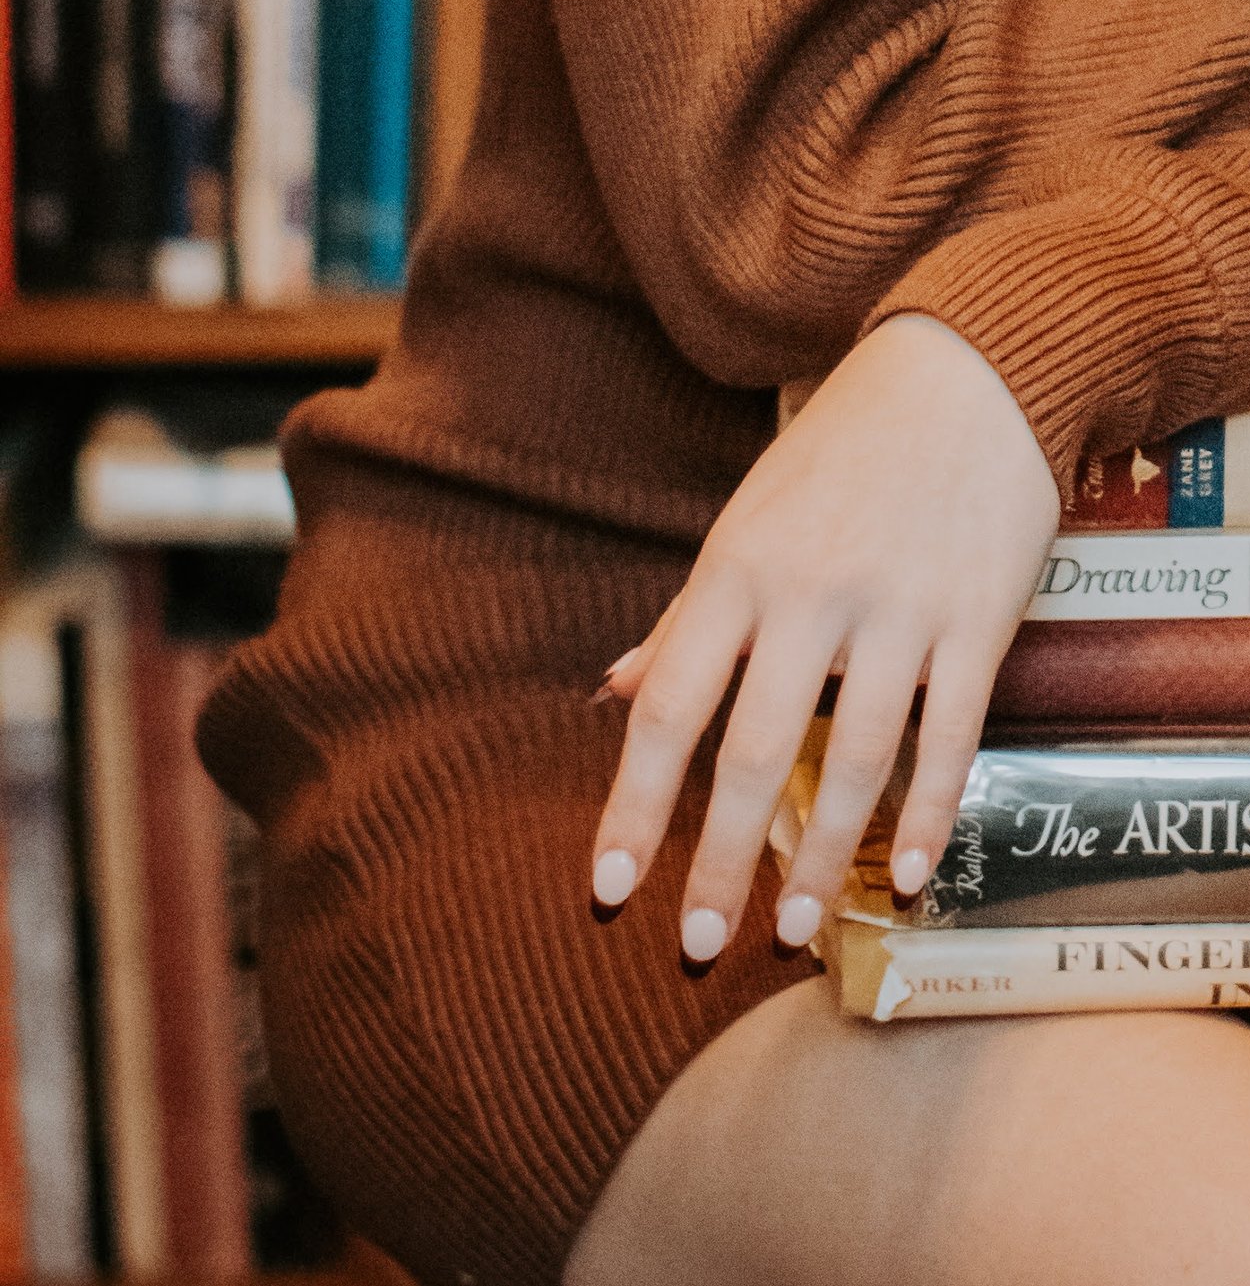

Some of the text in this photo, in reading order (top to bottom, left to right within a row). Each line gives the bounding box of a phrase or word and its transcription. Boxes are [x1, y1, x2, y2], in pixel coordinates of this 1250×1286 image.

[1180, 447, 1195, 498] ZANE
[1198, 447, 1213, 498] GREY
[1038, 556, 1232, 610] Drawing
[1011, 802, 1101, 857] The
[956, 831, 989, 900] Ralph
